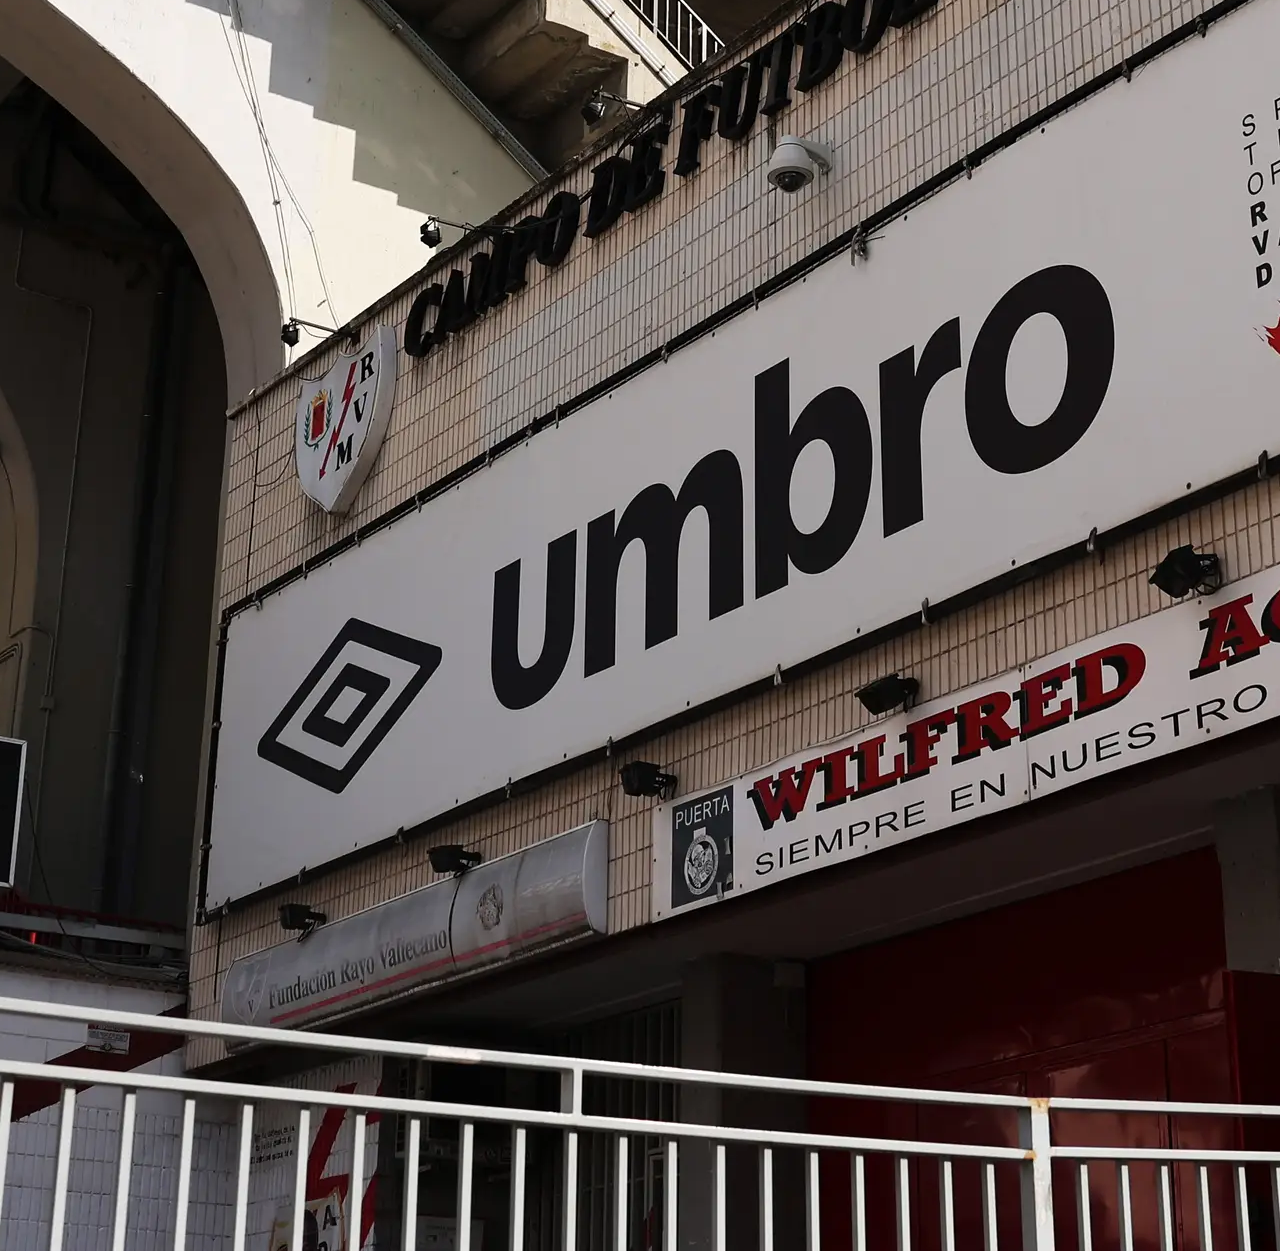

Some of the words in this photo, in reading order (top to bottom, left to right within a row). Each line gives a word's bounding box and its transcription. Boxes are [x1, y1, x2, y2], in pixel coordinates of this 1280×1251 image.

[404, 191, 580, 358] CAMPO
[583, 99, 673, 239] DE
[491, 264, 1115, 710] umbro
[675, 794, 730, 830] PUERTA
[747, 642, 1147, 831] WILFRED
[755, 800, 926, 876] SIEMPRE
[950, 773, 1006, 813] EN
[1032, 683, 1268, 786] NUESTRO
[269, 968, 336, 1009] Fundación
[340, 957, 375, 985] Rayo
[380, 929, 447, 970] Vallecano
